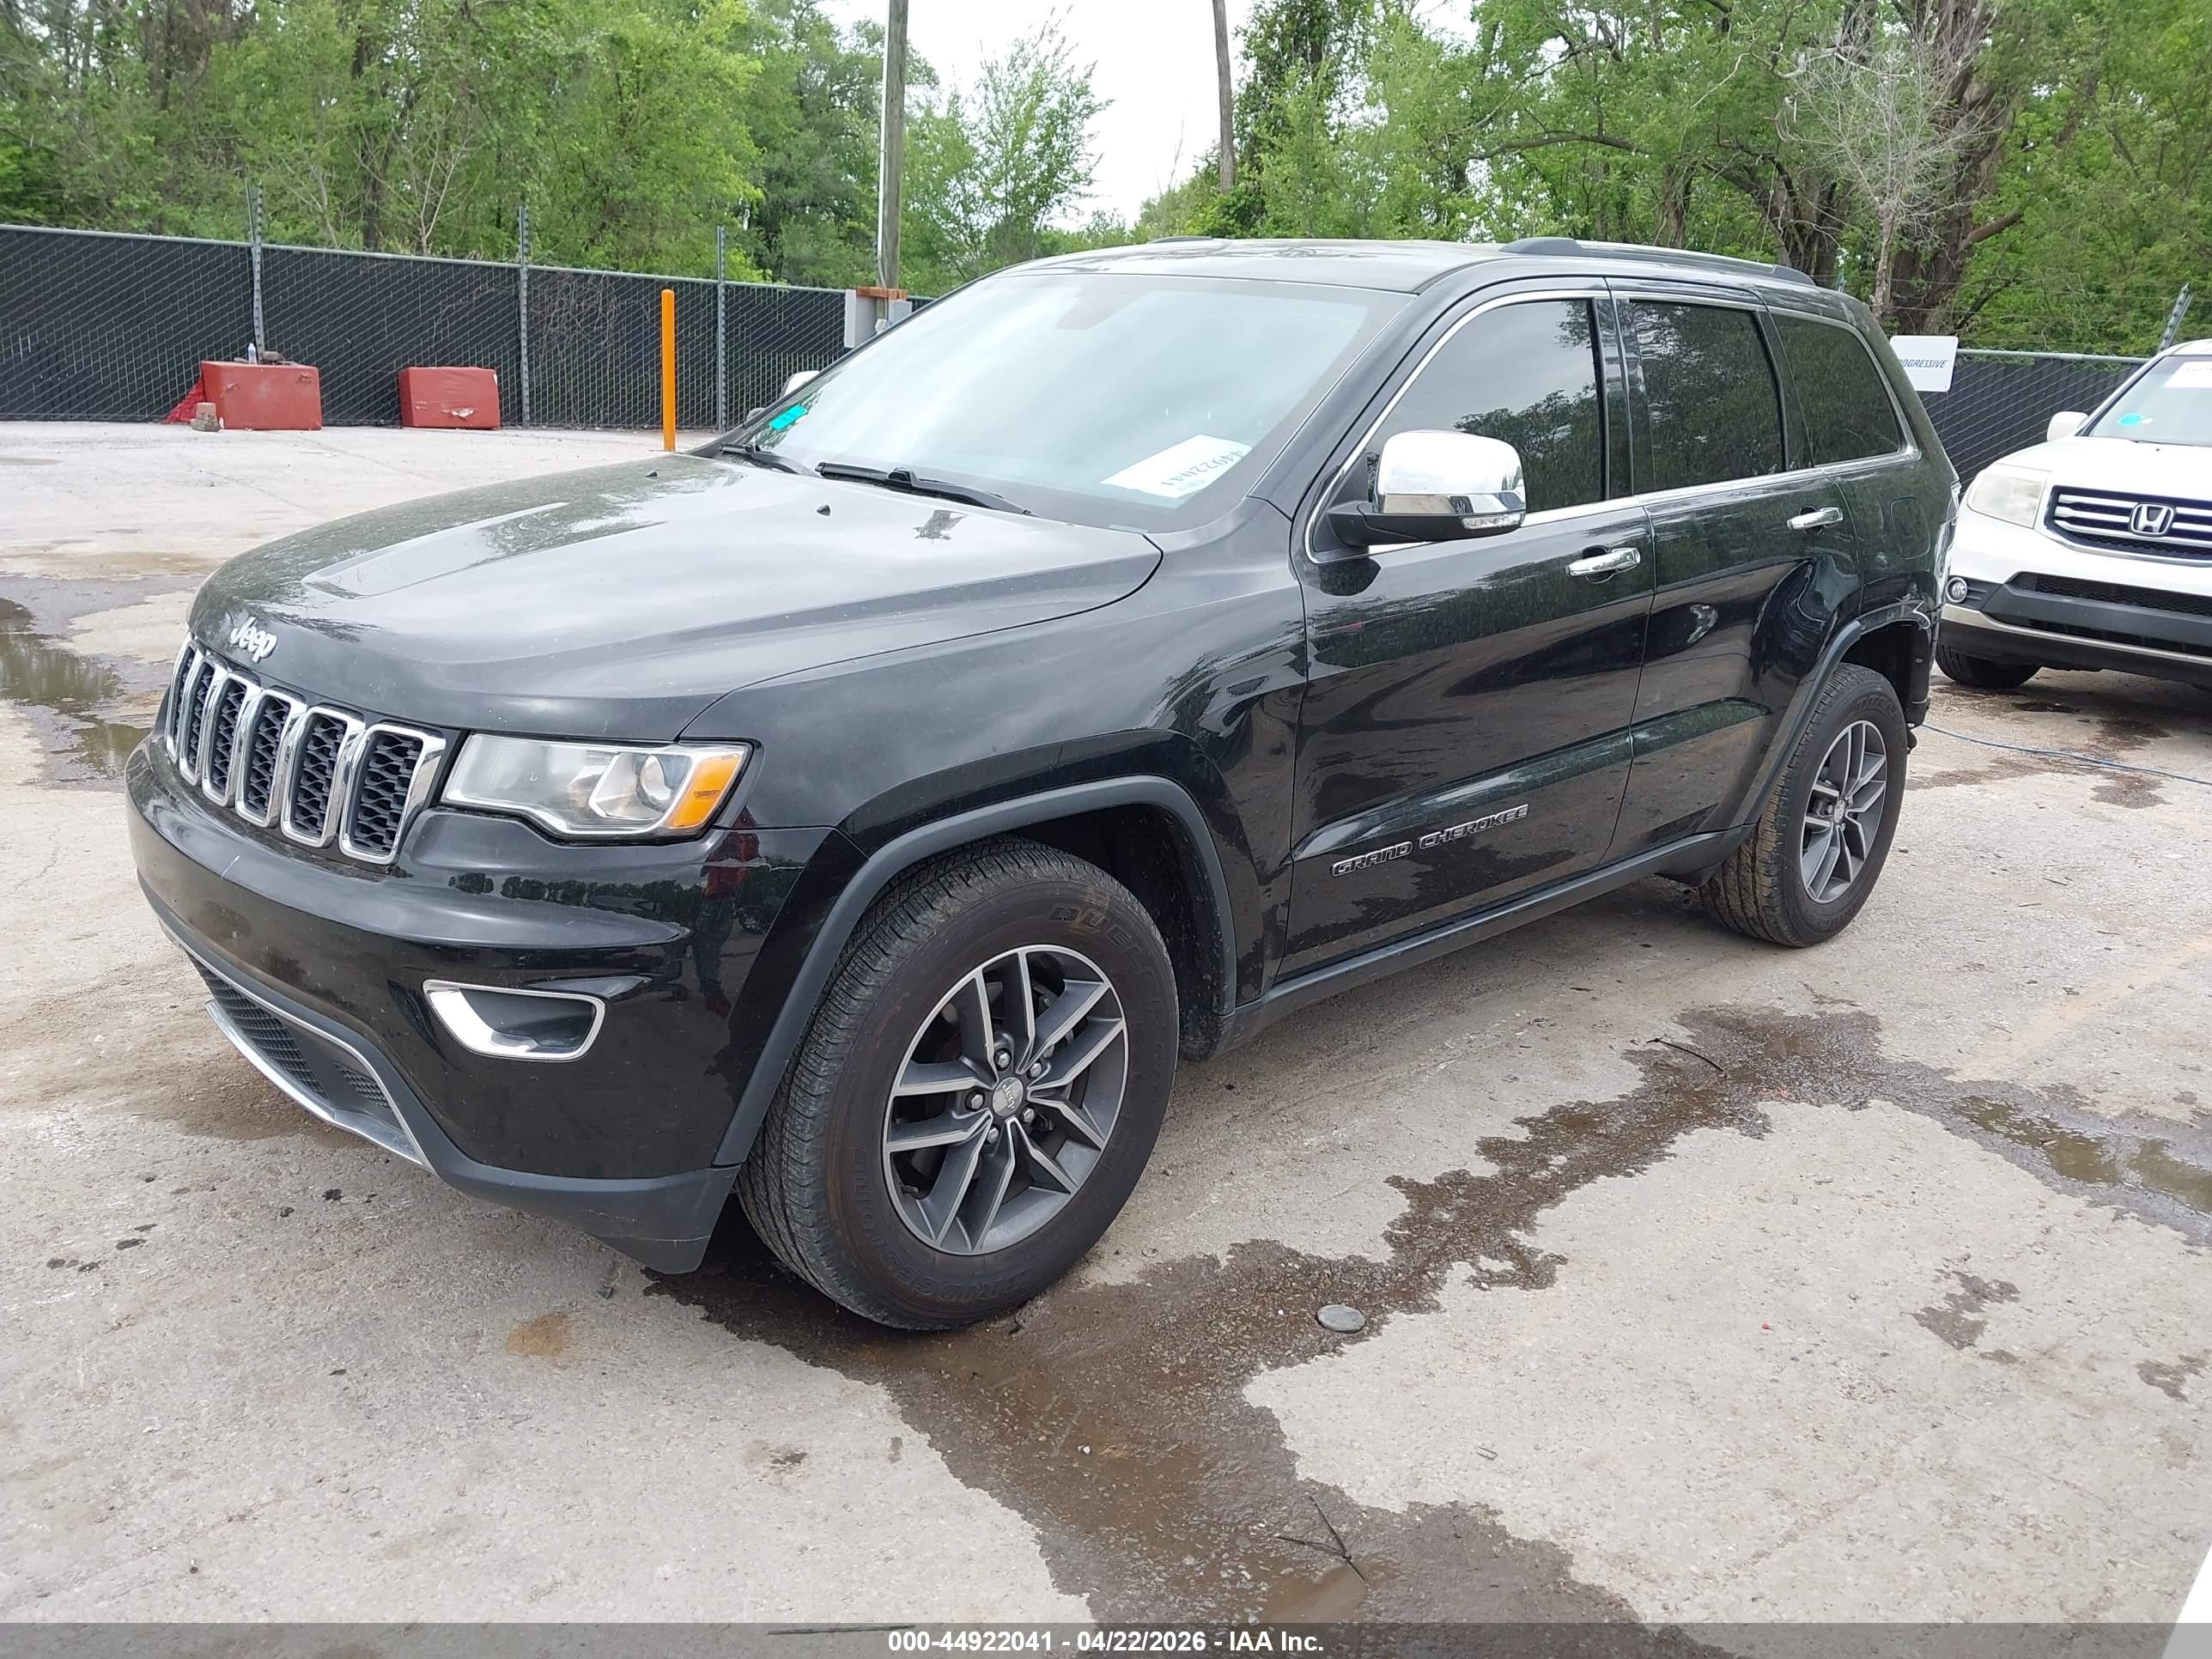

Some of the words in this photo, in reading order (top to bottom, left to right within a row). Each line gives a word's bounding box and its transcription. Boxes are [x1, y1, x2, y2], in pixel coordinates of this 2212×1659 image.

[1900, 359, 1948, 368] OGRESSIVE
[1161, 450, 1244, 486] 44922041
[229, 616, 278, 664] Jeep
[1332, 841, 1413, 877] GRAND
[1419, 804, 1529, 850] CHEROKEE
[1002, 1084, 1017, 1109] Jeep
